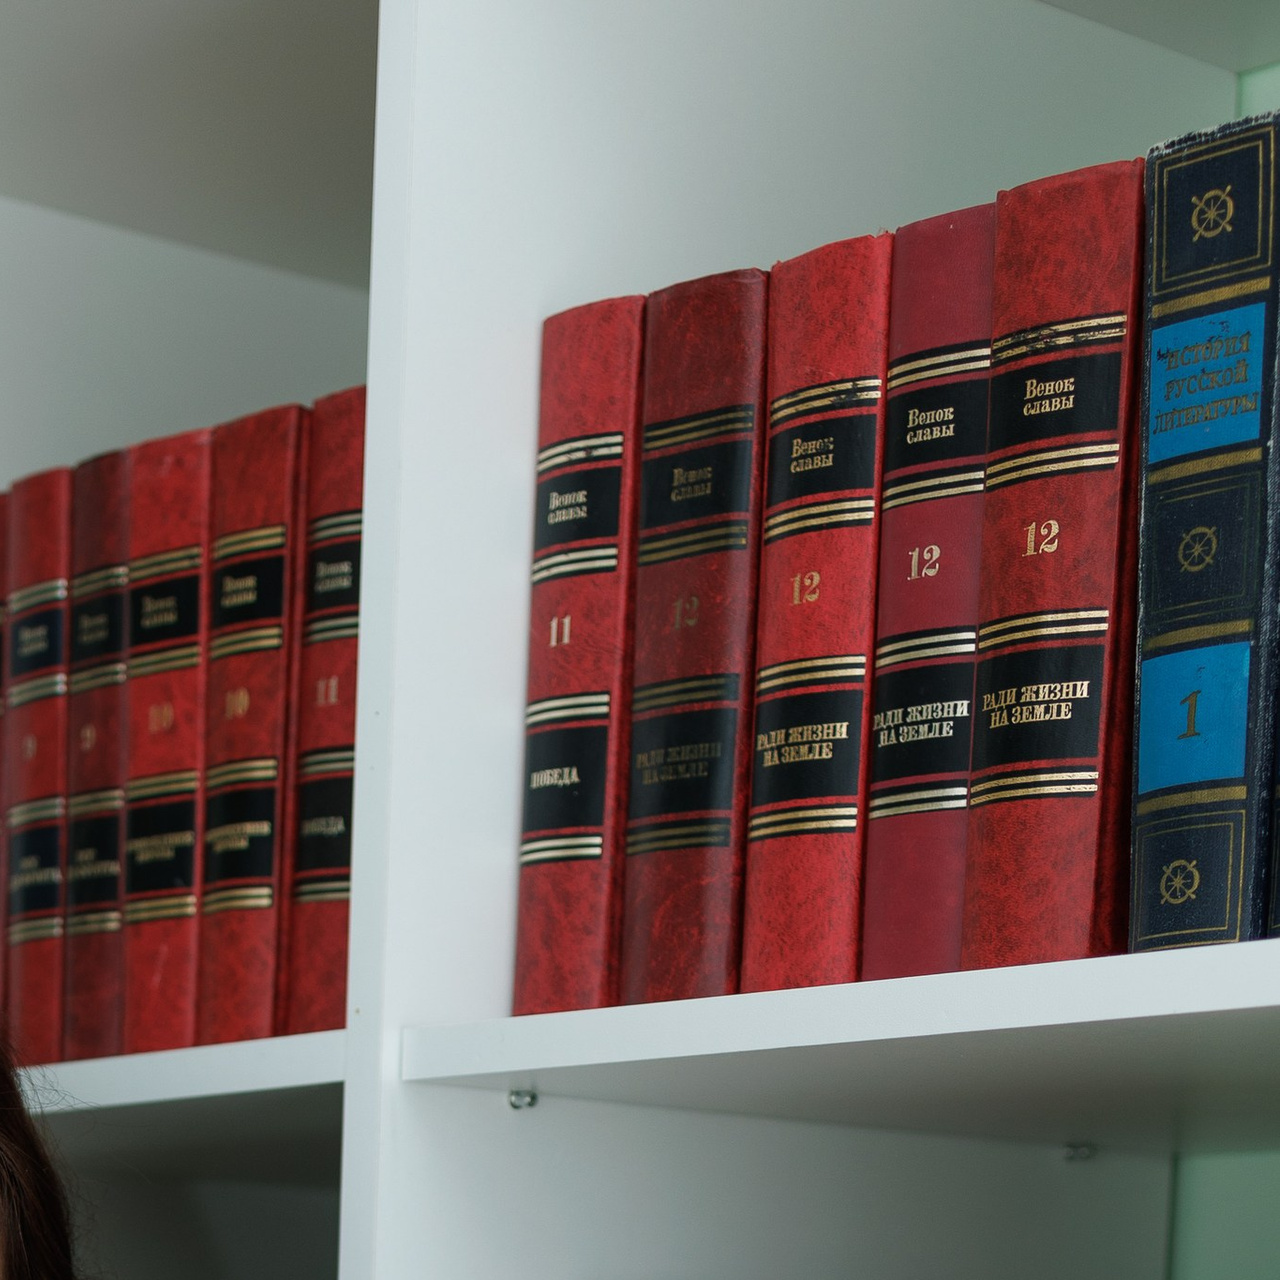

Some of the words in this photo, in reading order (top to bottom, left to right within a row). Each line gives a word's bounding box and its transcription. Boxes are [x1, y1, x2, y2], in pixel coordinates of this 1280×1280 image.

[1165, 331, 1251, 371] ИСТОРИЯ
[1024, 376, 1075, 400] Венок
[1164, 359, 1249, 401] РУССКОЙ
[907, 406, 955, 428] Венок
[1023, 394, 1075, 416] славы
[1153, 391, 1259, 435] ЛИТЕРАТУРЫ
[792, 435, 835, 459] Венок
[906, 423, 955, 444] славы
[790, 453, 835, 473] славы
[1021, 519, 1060, 558] 12
[906, 544, 941, 581] 12
[789, 570, 821, 606] 12
[549, 614, 571, 648] 11
[982, 688, 1018, 711] РАДИ
[1020, 680, 1090, 702] ЖИЗНИ
[873, 707, 903, 729] РАДИ
[906, 699, 970, 723] ЖИЗНИ
[989, 706, 1011, 728] НА
[1011, 702, 1072, 724] ЗЕМЛЕ
[1177, 690, 1201, 740] 1
[756, 729, 786, 751] РАДИ
[788, 721, 849, 745] ЖИЗНИ
[878, 727, 897, 747] НА
[898, 720, 954, 742] ЗЕМЛЕ
[763, 747, 781, 767] НА
[781, 741, 833, 764] ЗЕМЛЕ
[530, 766, 580, 790] ПОБЕДА
